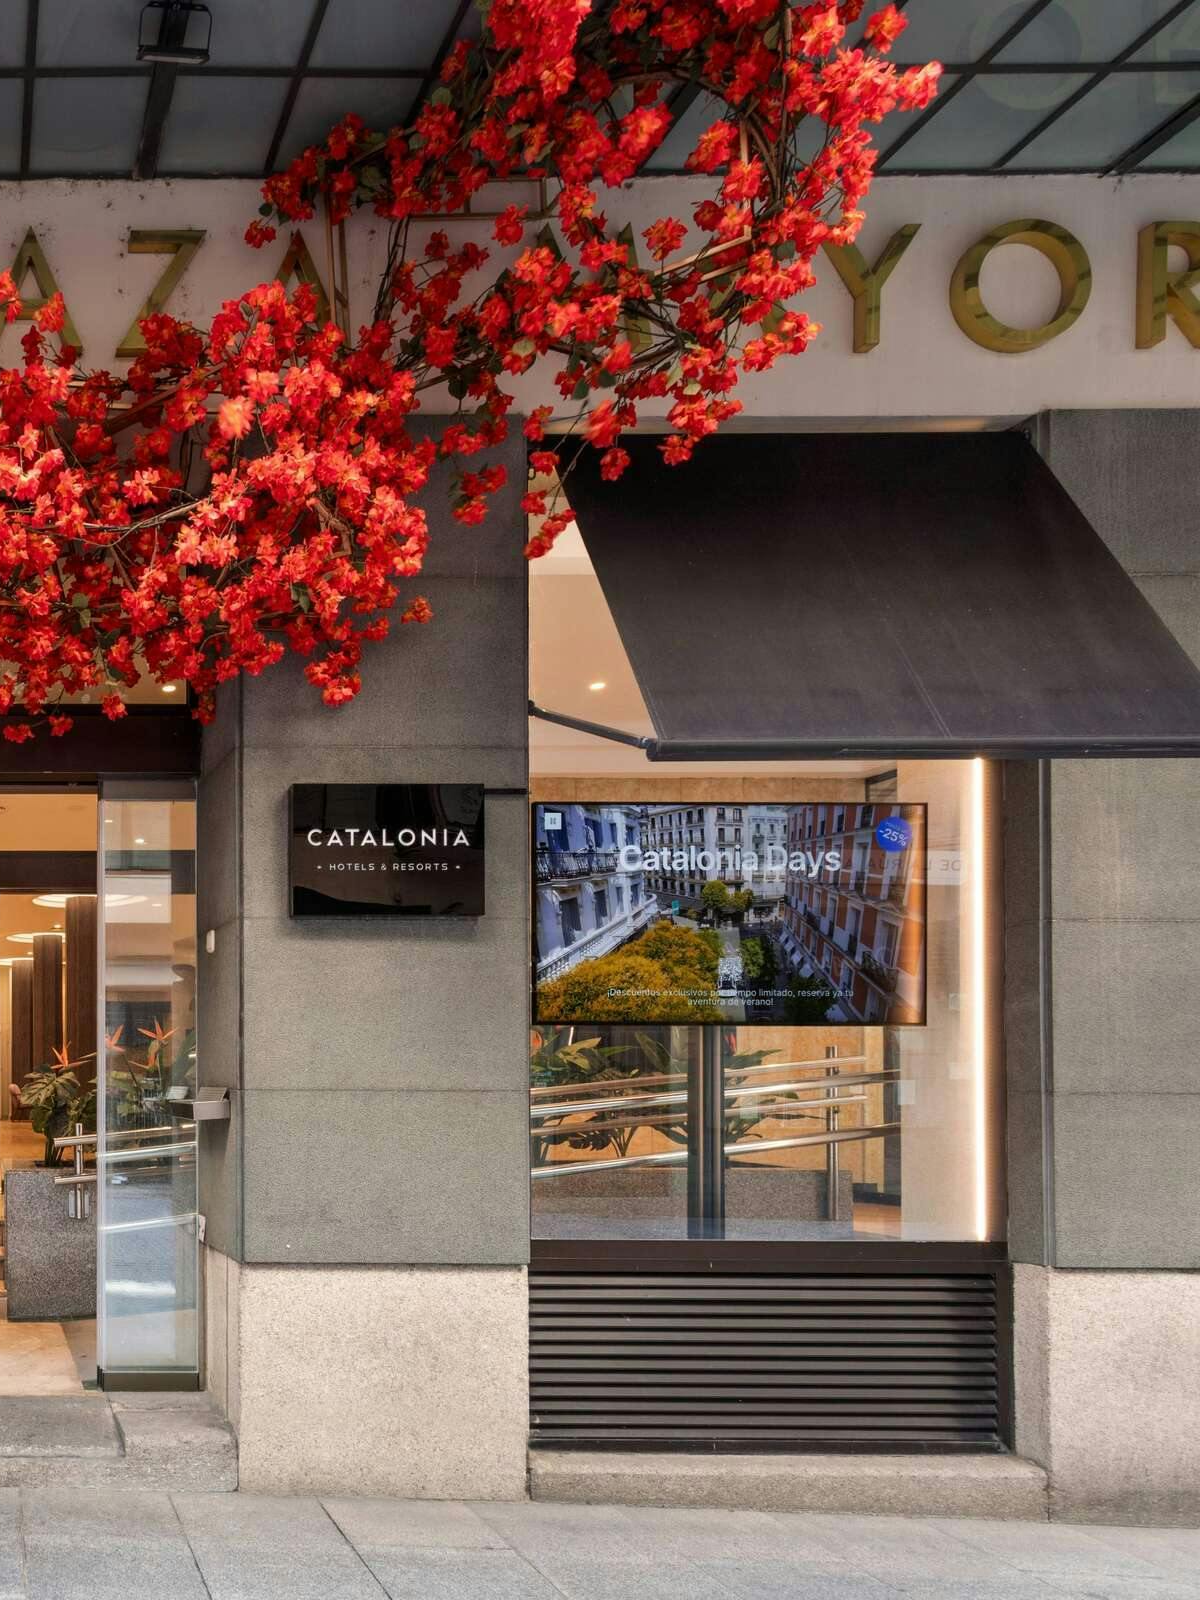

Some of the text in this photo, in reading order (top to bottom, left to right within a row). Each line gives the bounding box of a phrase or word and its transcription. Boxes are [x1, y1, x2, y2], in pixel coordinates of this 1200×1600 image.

[307, 828, 470, 846] CATALONIA
[878, 827, 908, 847] -25%
[329, 863, 448, 871] HOTELS & RESORTS
[619, 844, 758, 871] Catalonia
[766, 845, 841, 877] Days
[663, 988, 708, 996] exclusivos
[759, 988, 796, 998] limitado,
